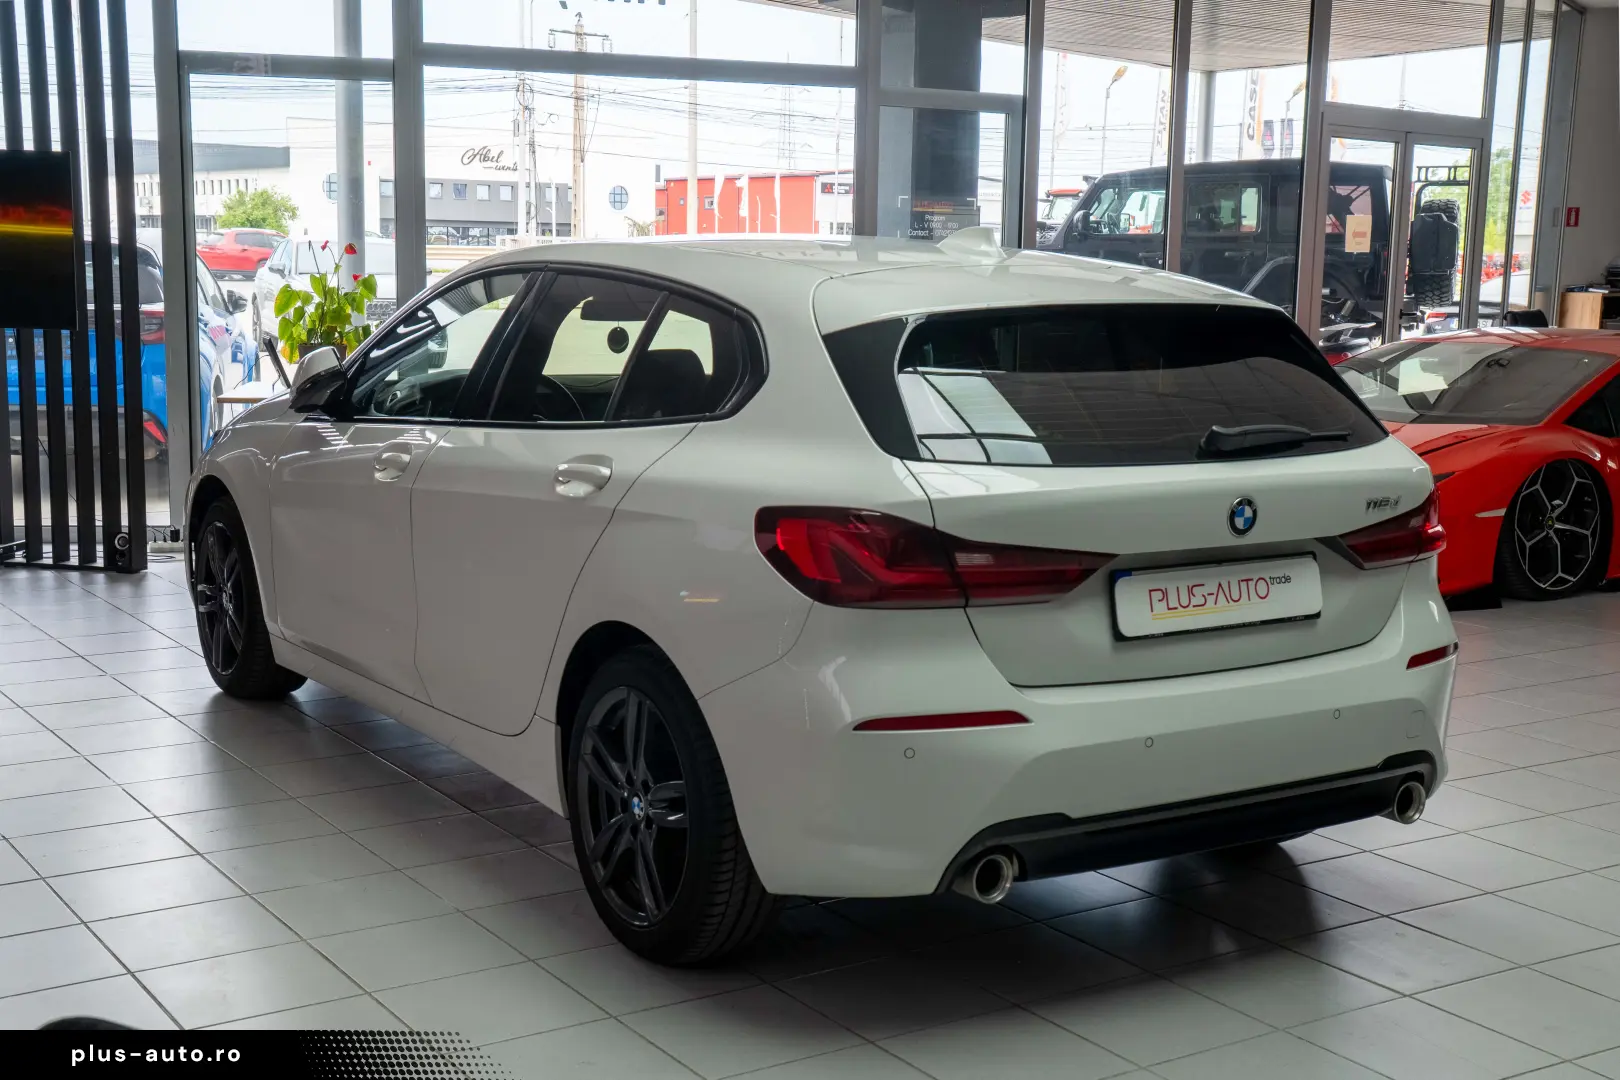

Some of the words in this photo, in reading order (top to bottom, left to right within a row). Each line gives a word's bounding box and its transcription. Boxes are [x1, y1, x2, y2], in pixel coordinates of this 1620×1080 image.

[1247, 69, 1260, 141] CASE
[461, 146, 504, 165] Abel
[925, 214, 946, 222] Program
[908, 228, 929, 237] Contact
[1149, 577, 1270, 613] PLUS-AUTO
[1269, 573, 1291, 585] trade
